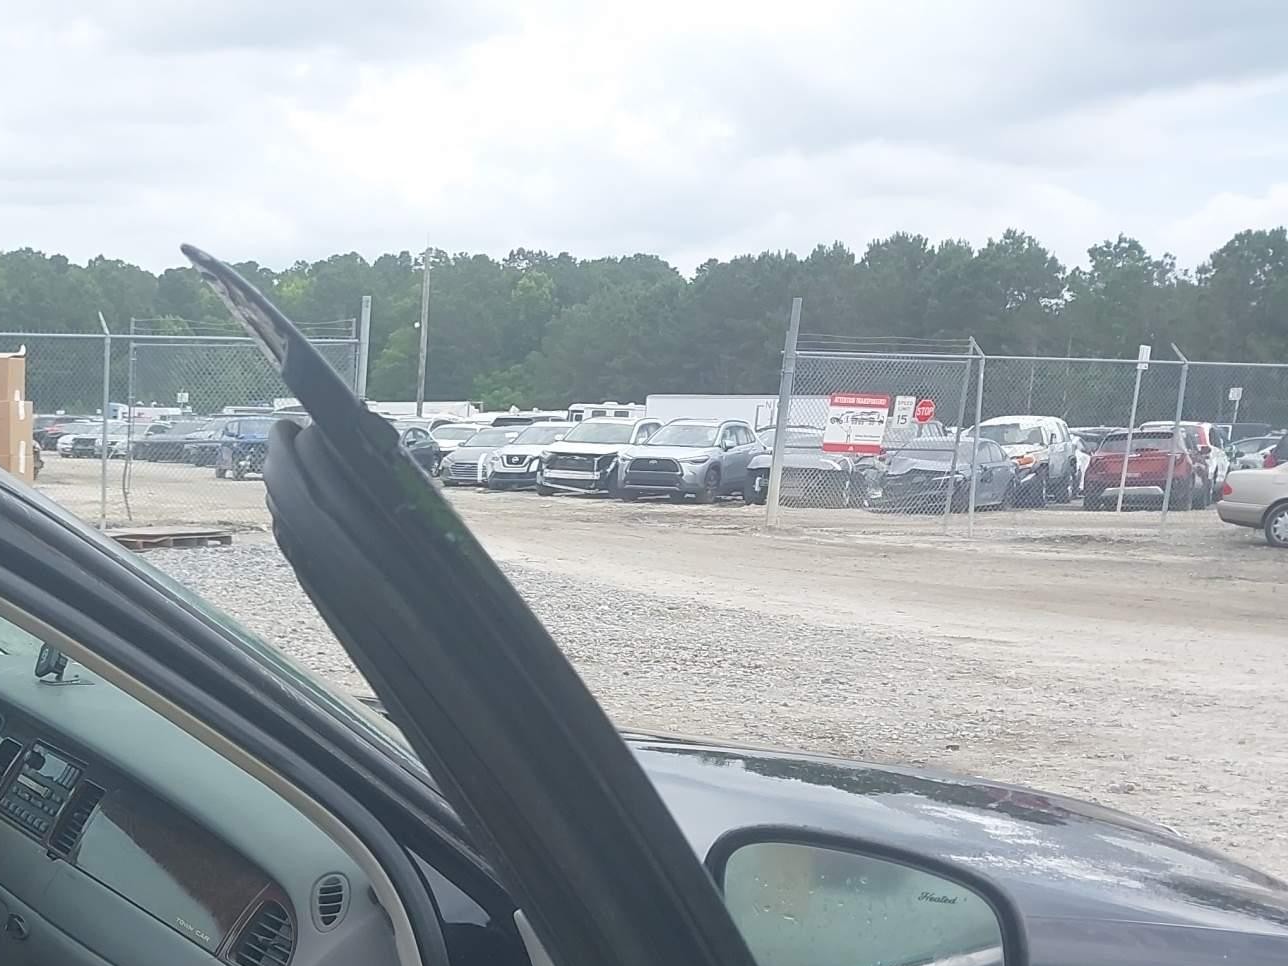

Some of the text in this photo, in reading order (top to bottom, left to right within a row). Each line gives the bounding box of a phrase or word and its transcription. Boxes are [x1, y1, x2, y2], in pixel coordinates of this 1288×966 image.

[916, 407, 934, 416] STOP
[897, 414, 908, 424] 15
[195, 930, 210, 942] CAR
